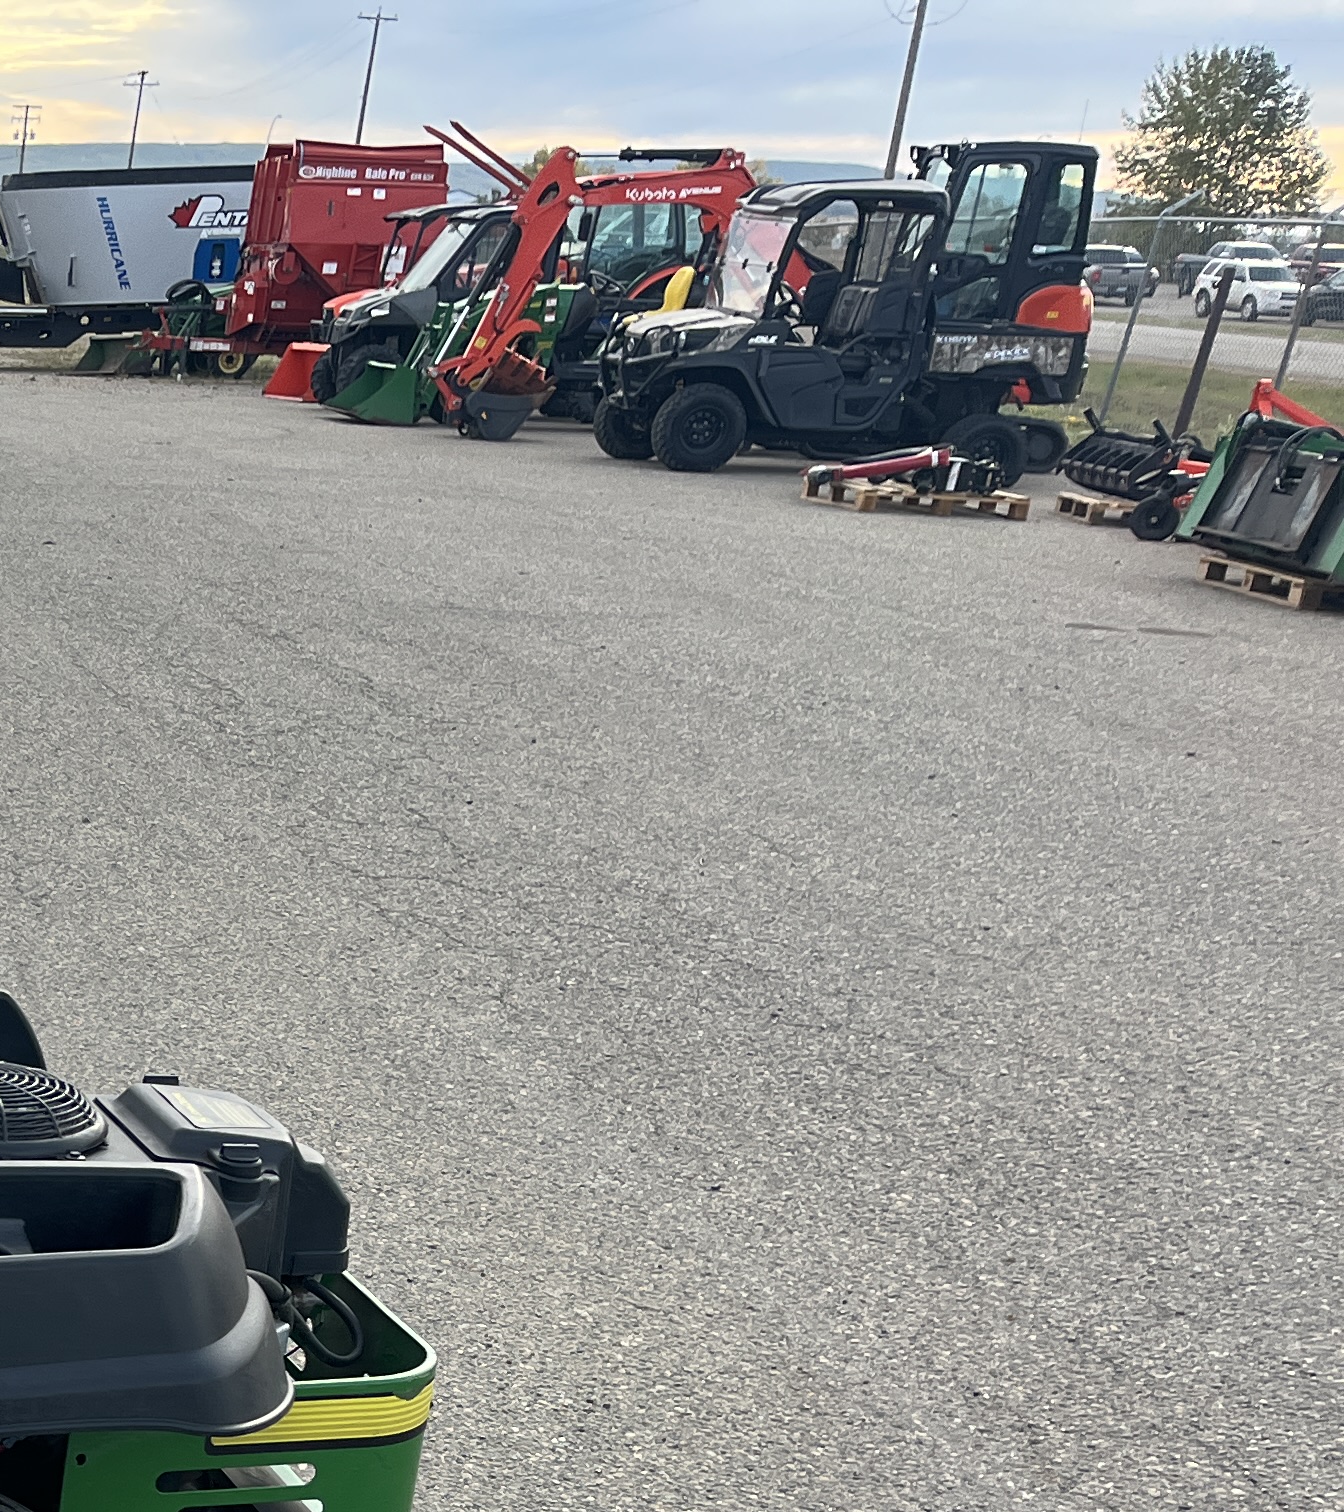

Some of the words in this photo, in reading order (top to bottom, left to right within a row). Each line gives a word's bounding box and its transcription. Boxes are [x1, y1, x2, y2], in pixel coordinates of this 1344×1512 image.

[389, 168, 406, 180] Pro
[625, 187, 677, 201] Kubota
[96, 196, 132, 291] HURRICANE
